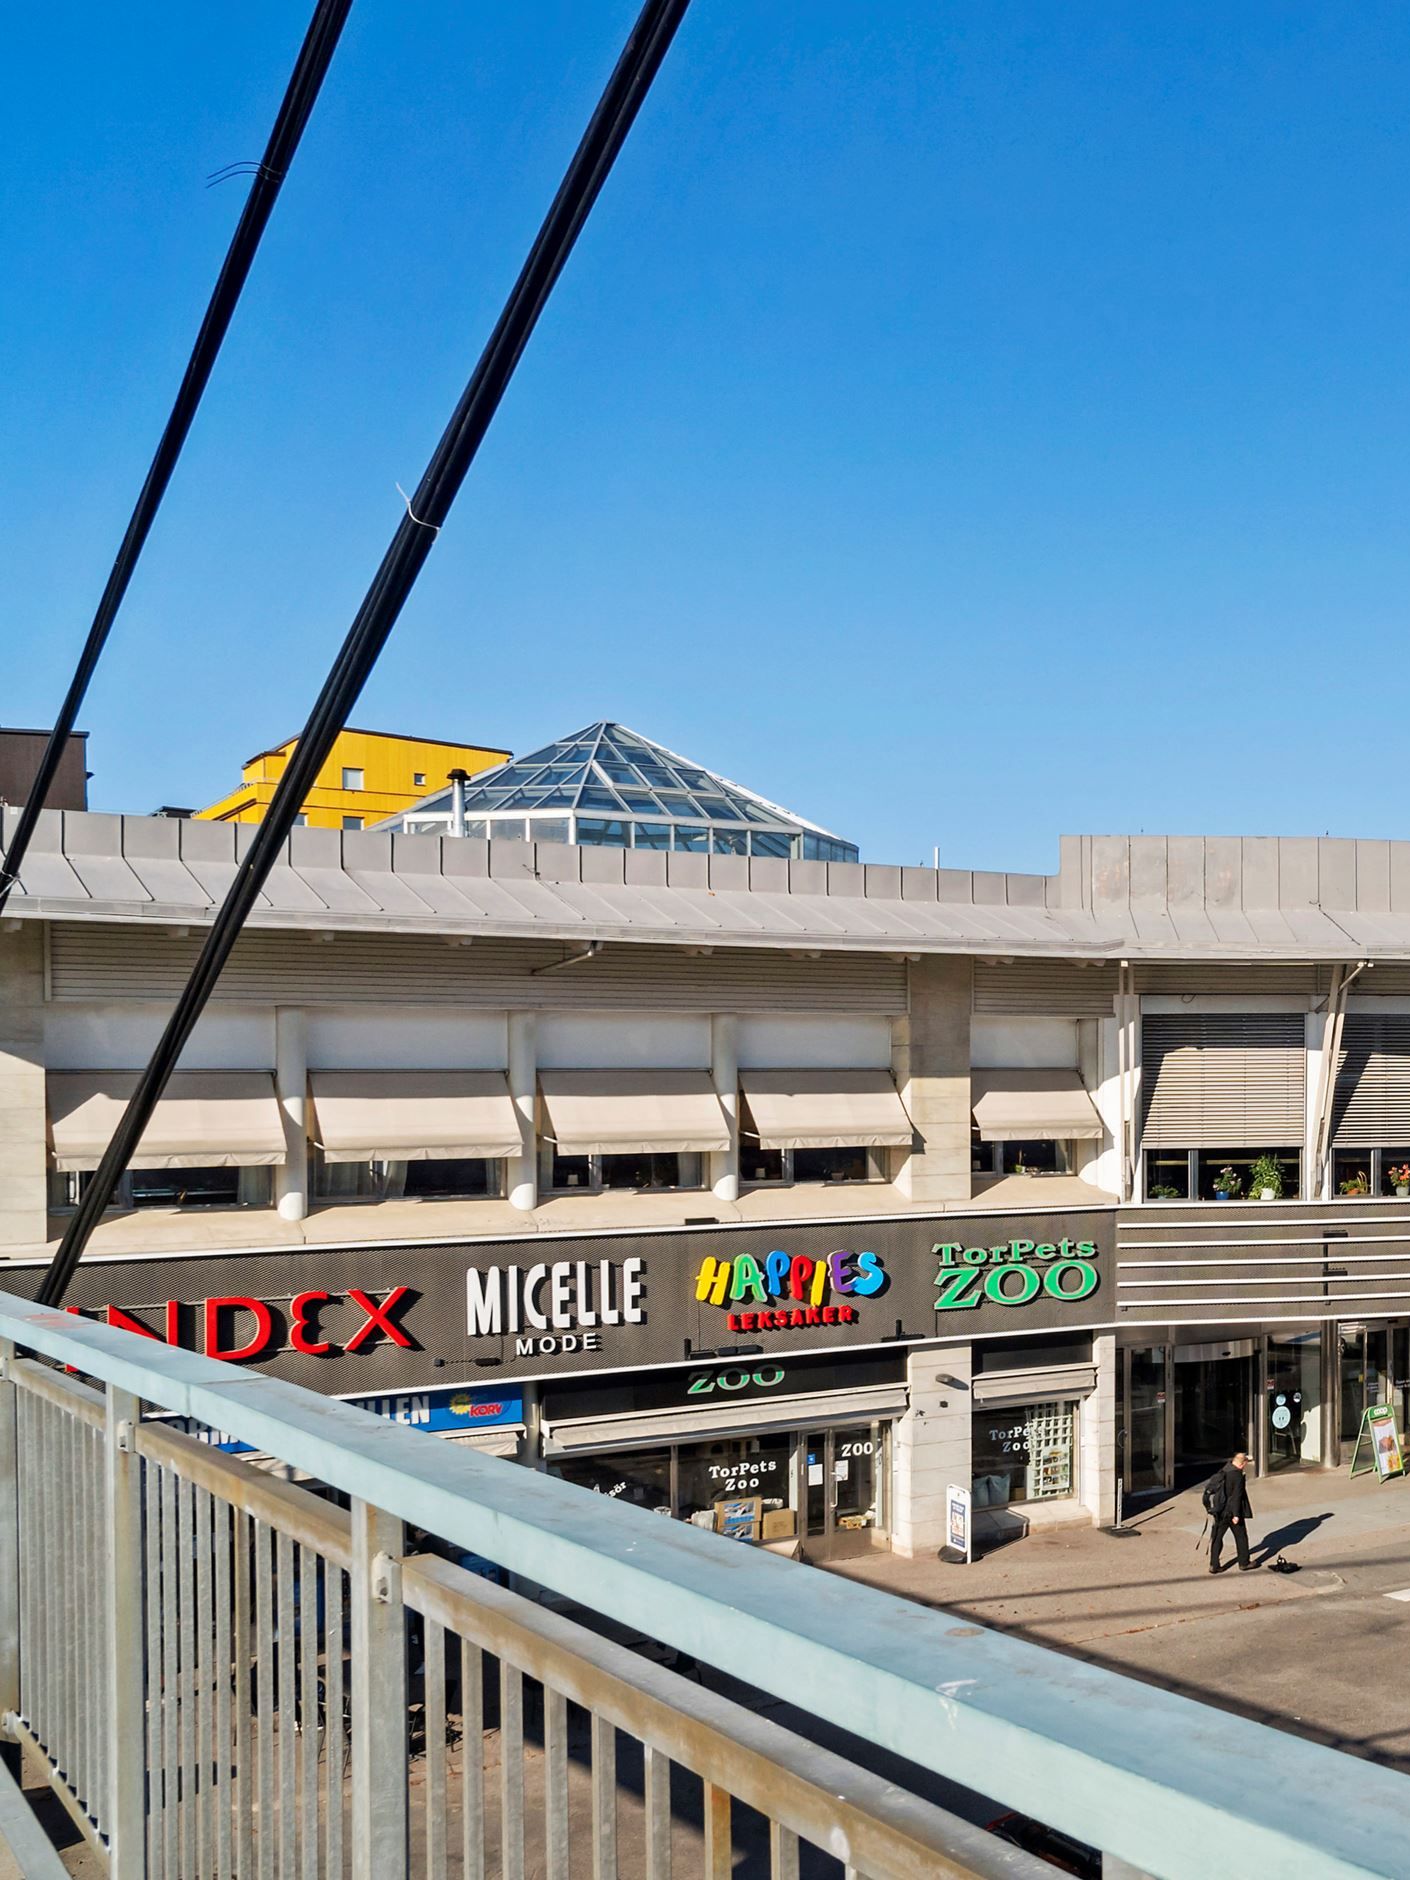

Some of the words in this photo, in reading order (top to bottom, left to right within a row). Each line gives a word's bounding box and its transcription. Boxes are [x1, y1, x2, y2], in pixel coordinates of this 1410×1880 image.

[932, 1237, 1096, 1267] TorPets
[696, 1250, 885, 1306] HAPPIES
[934, 1260, 1098, 1310] ZOO
[467, 1257, 642, 1336] MICELLE
[727, 1305, 853, 1331] LEKSAKER
[516, 1333, 598, 1356] MODE
[687, 1364, 785, 1395] ZOO
[708, 1460, 777, 1480] TorPets
[724, 1478, 760, 1492] Zoo
